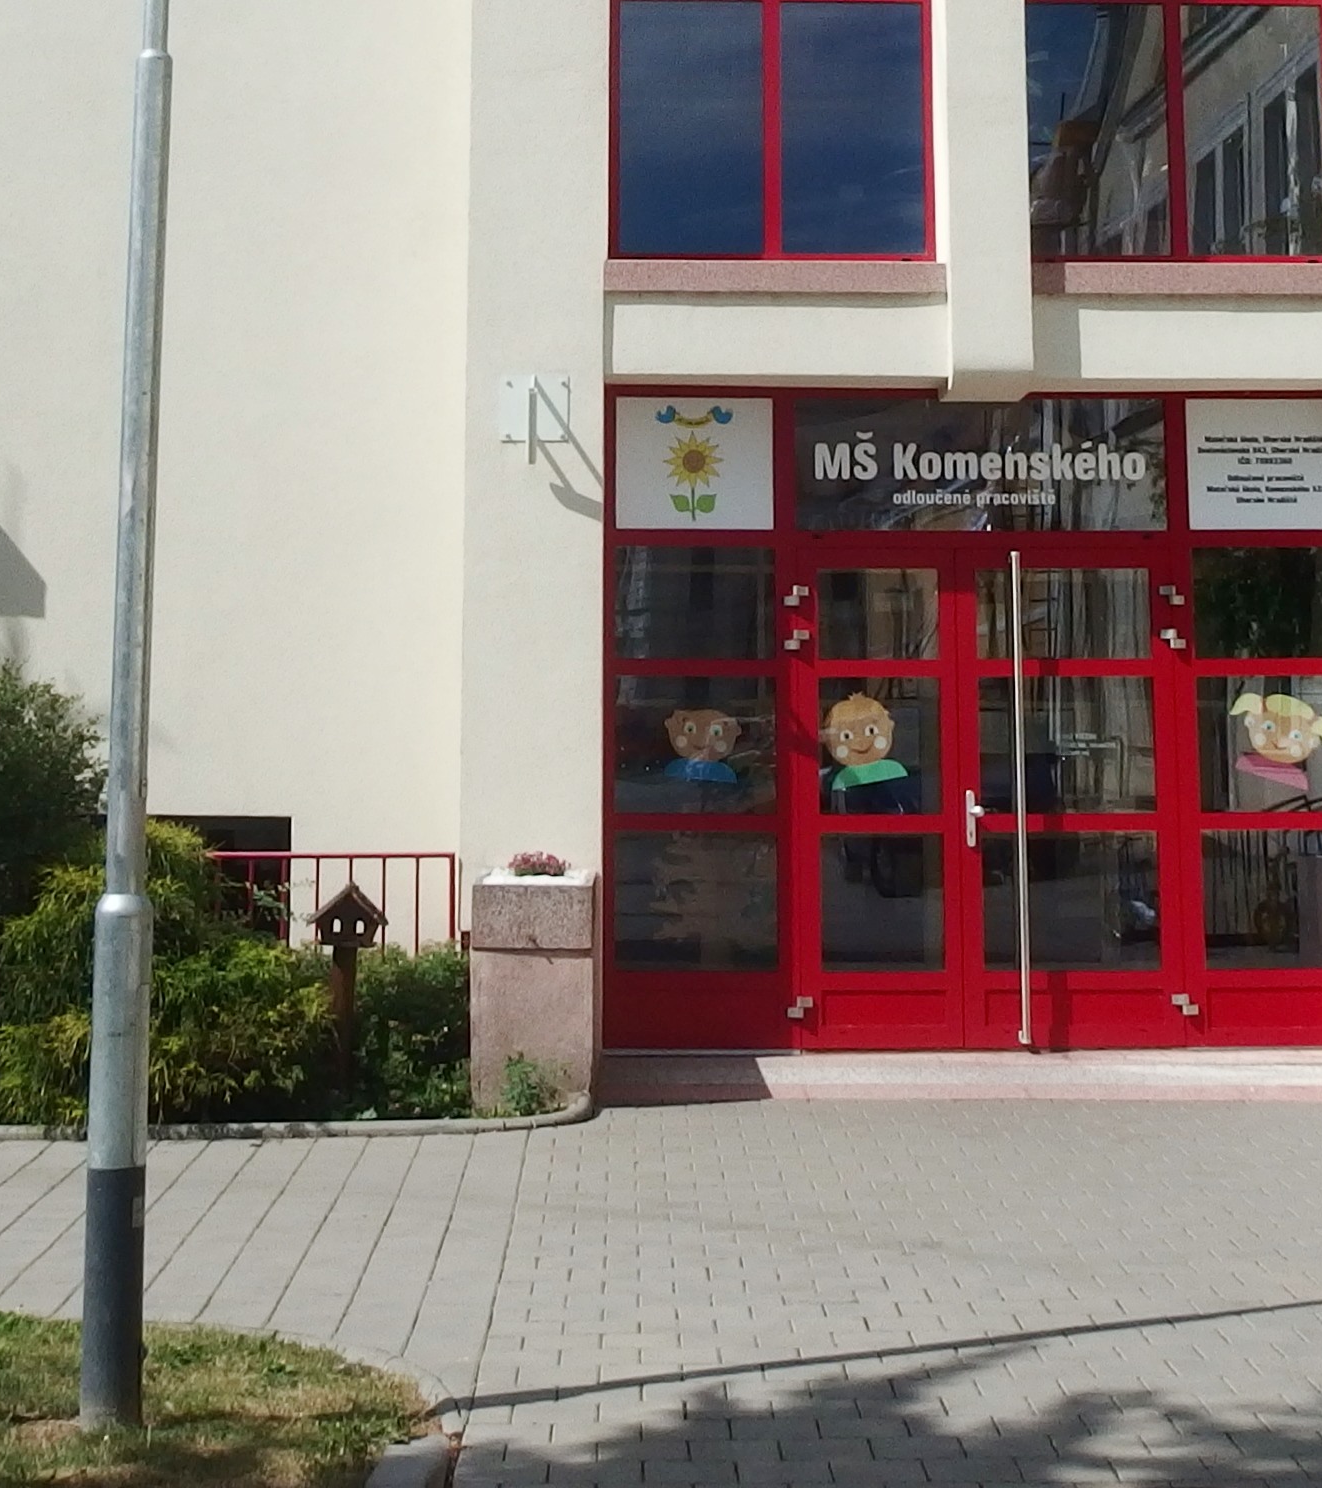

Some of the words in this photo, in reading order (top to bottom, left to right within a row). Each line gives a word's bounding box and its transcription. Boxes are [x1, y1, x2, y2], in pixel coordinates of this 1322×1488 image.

[814, 431, 878, 480] MŠ
[893, 440, 1147, 480] Komenského
[892, 488, 971, 505] odloučené
[976, 488, 1056, 508] pracoviště
